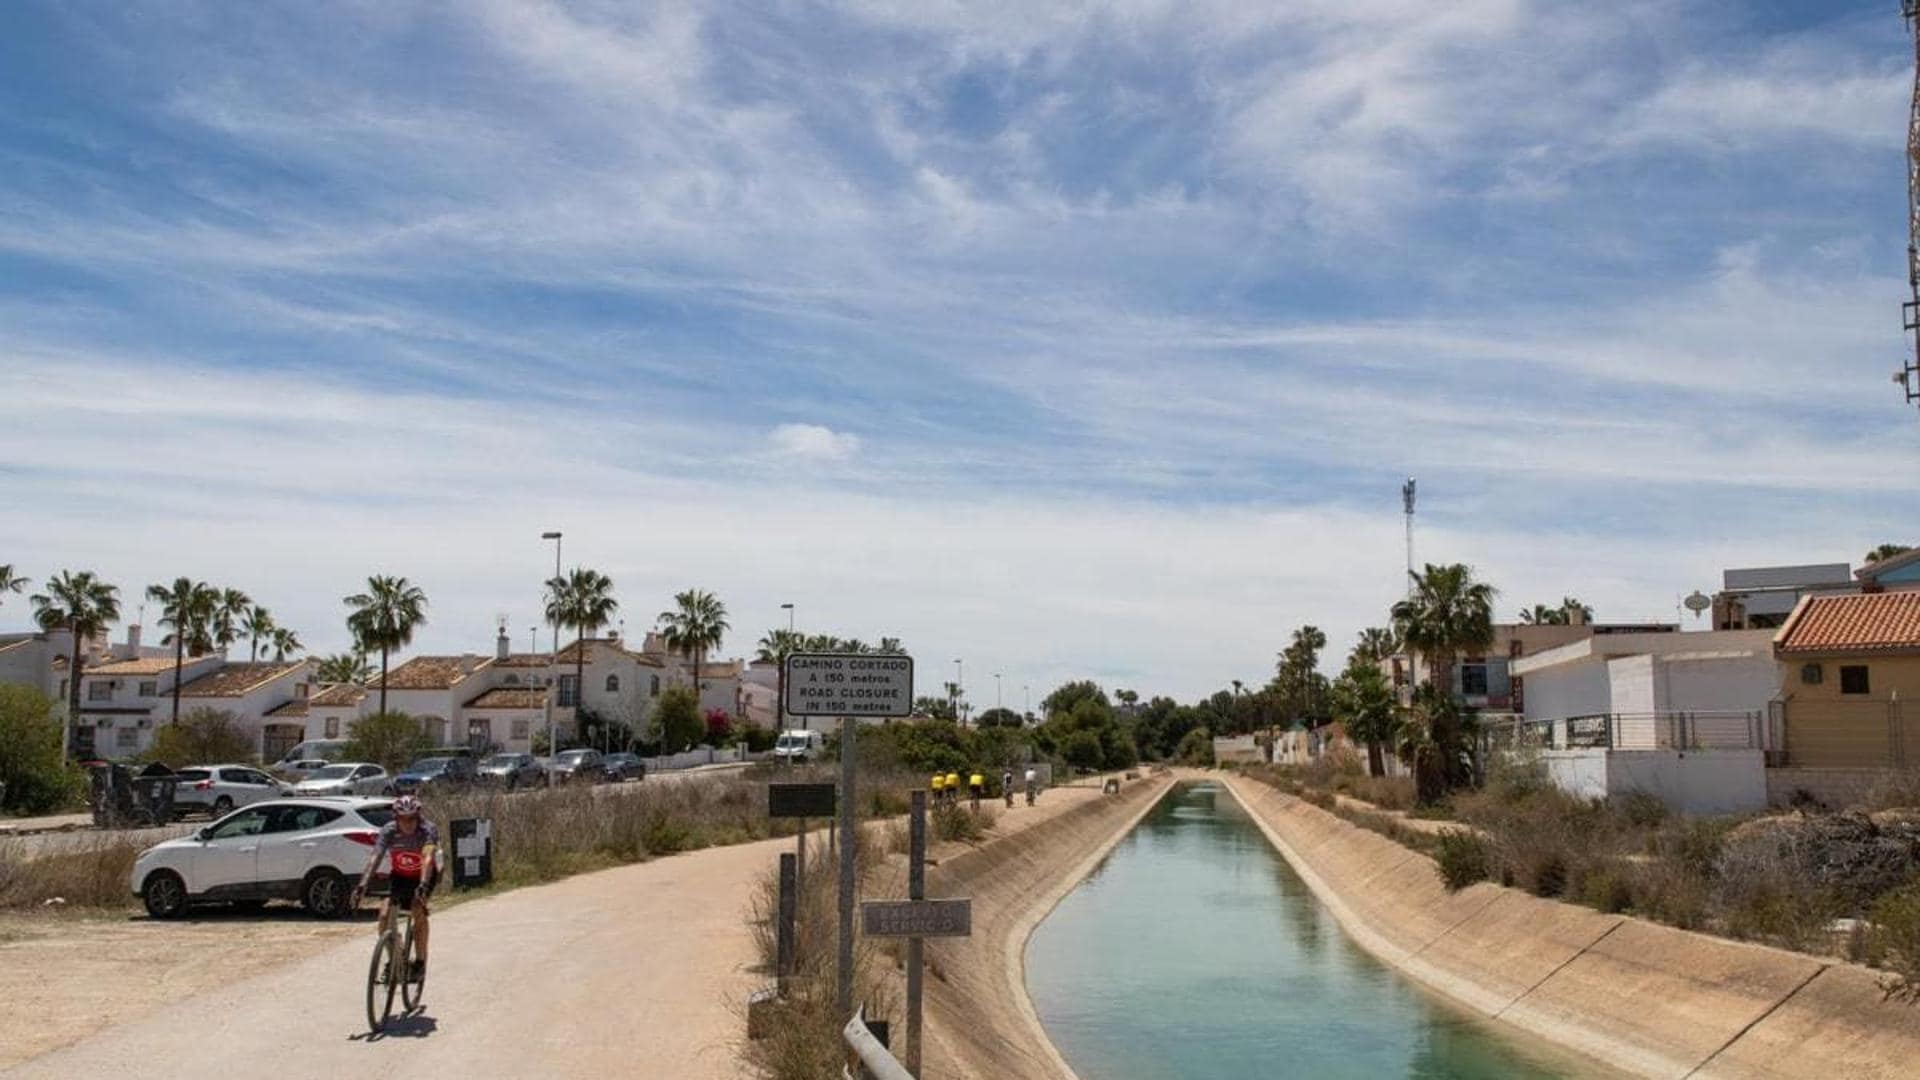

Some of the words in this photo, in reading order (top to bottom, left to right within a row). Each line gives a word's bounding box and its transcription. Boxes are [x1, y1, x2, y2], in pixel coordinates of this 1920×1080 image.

[792, 658, 843, 670] CAMINO
[849, 659, 908, 671] CORTADO
[809, 673, 817, 682] A
[825, 673, 844, 683] 150
[799, 687, 834, 697] ROAD
[840, 688, 898, 698] CLOSURE
[806, 701, 820, 711] IN
[826, 701, 846, 711] 150
